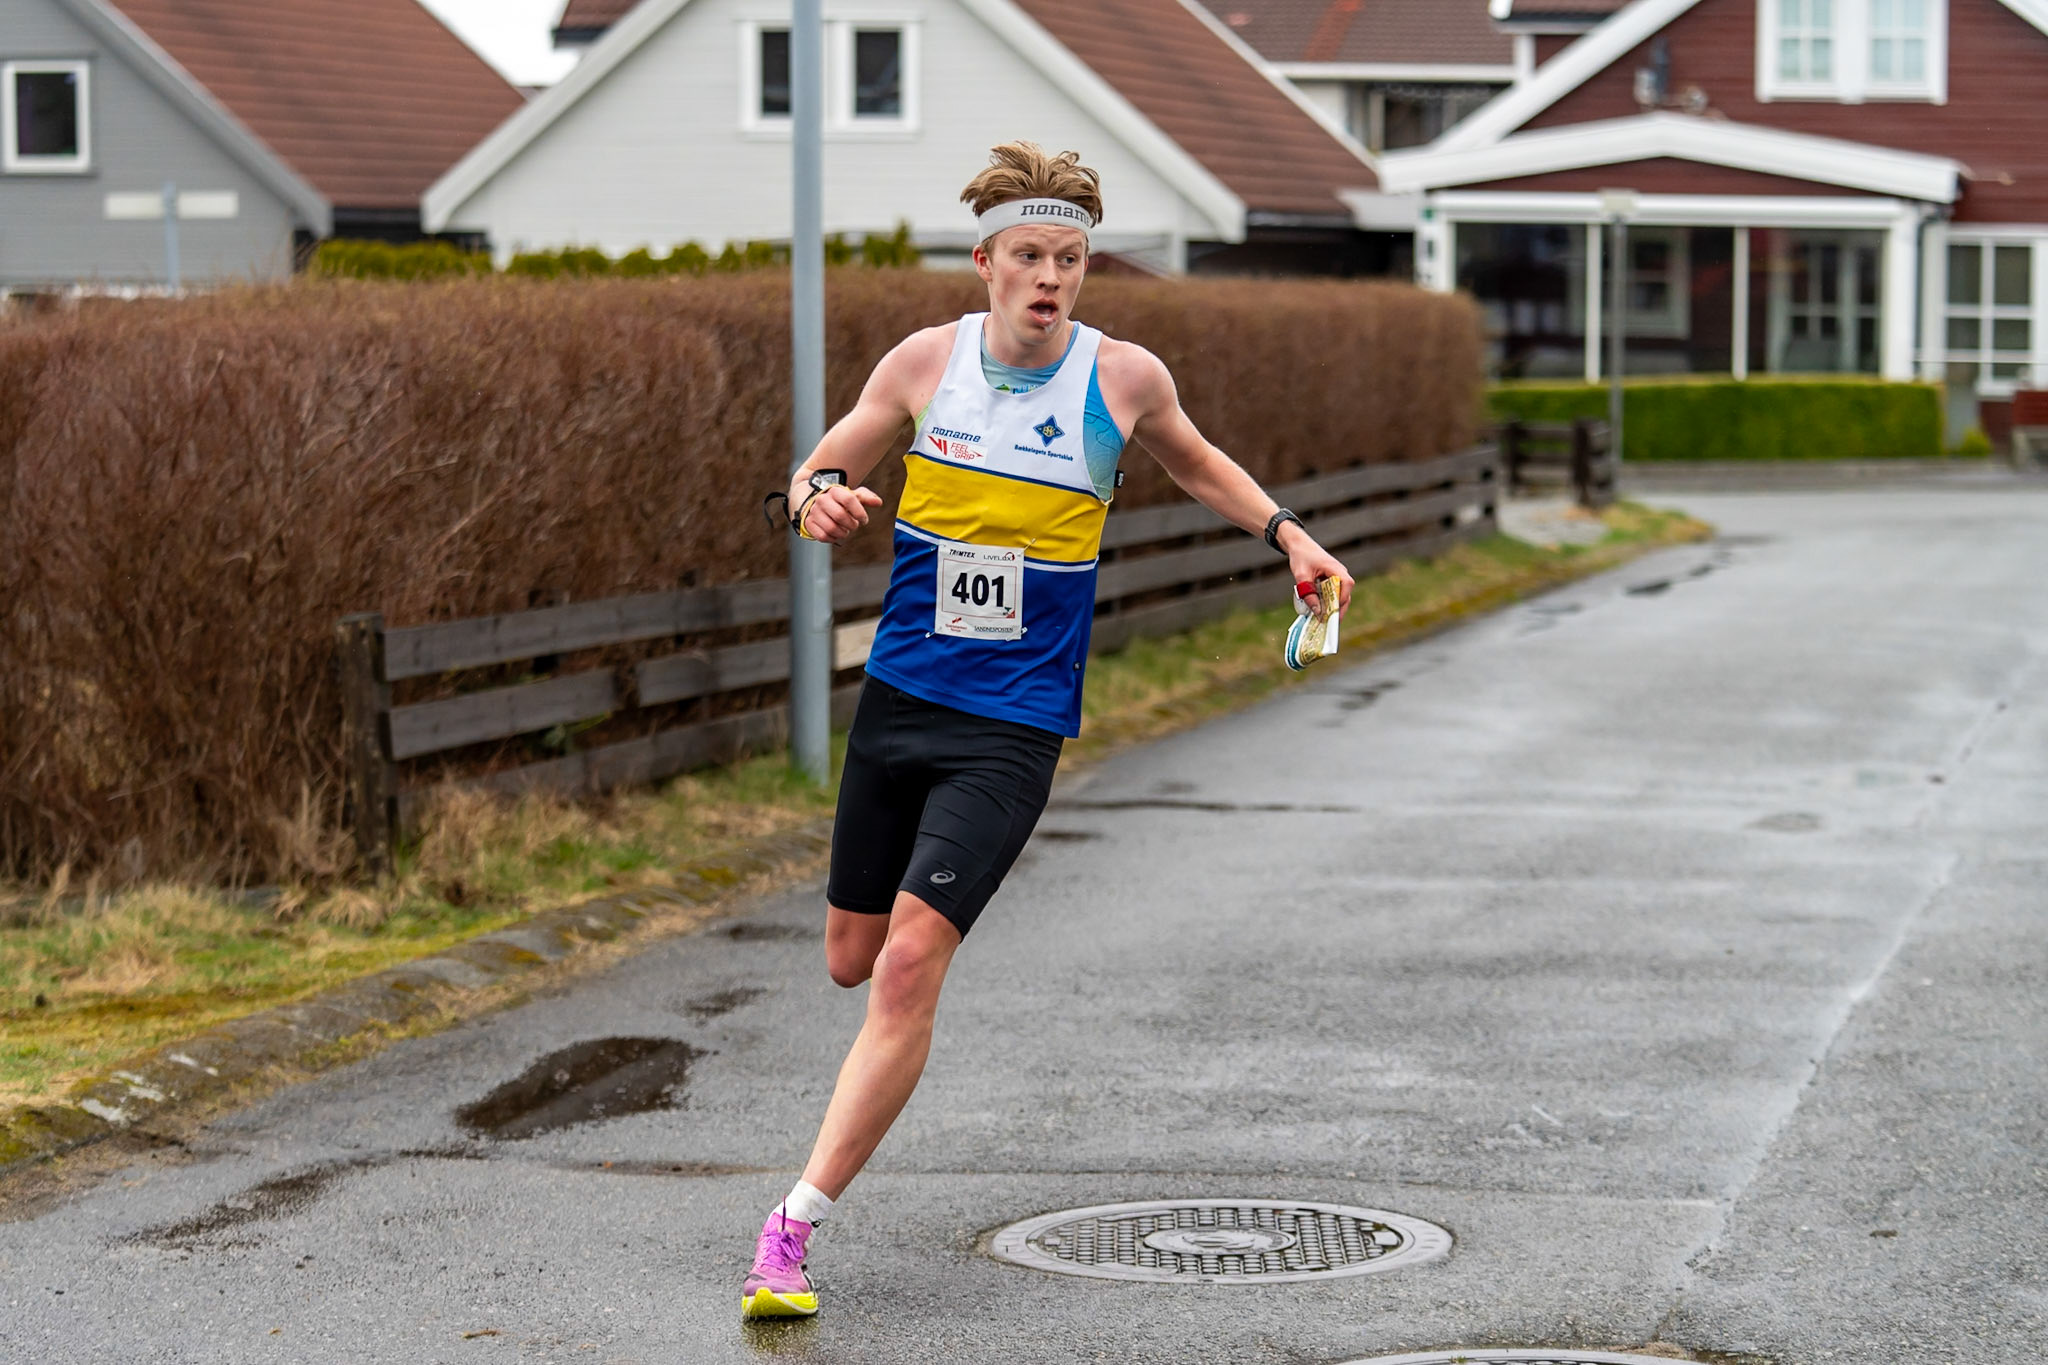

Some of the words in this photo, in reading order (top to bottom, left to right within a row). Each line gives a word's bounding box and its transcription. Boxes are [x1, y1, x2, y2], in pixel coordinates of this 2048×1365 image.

[931, 426, 981, 442] noname
[950, 442, 969, 454] FEEL
[954, 451, 975, 461] GRIP
[949, 548, 976, 559] TRIMTEX
[951, 572, 1005, 608] 401
